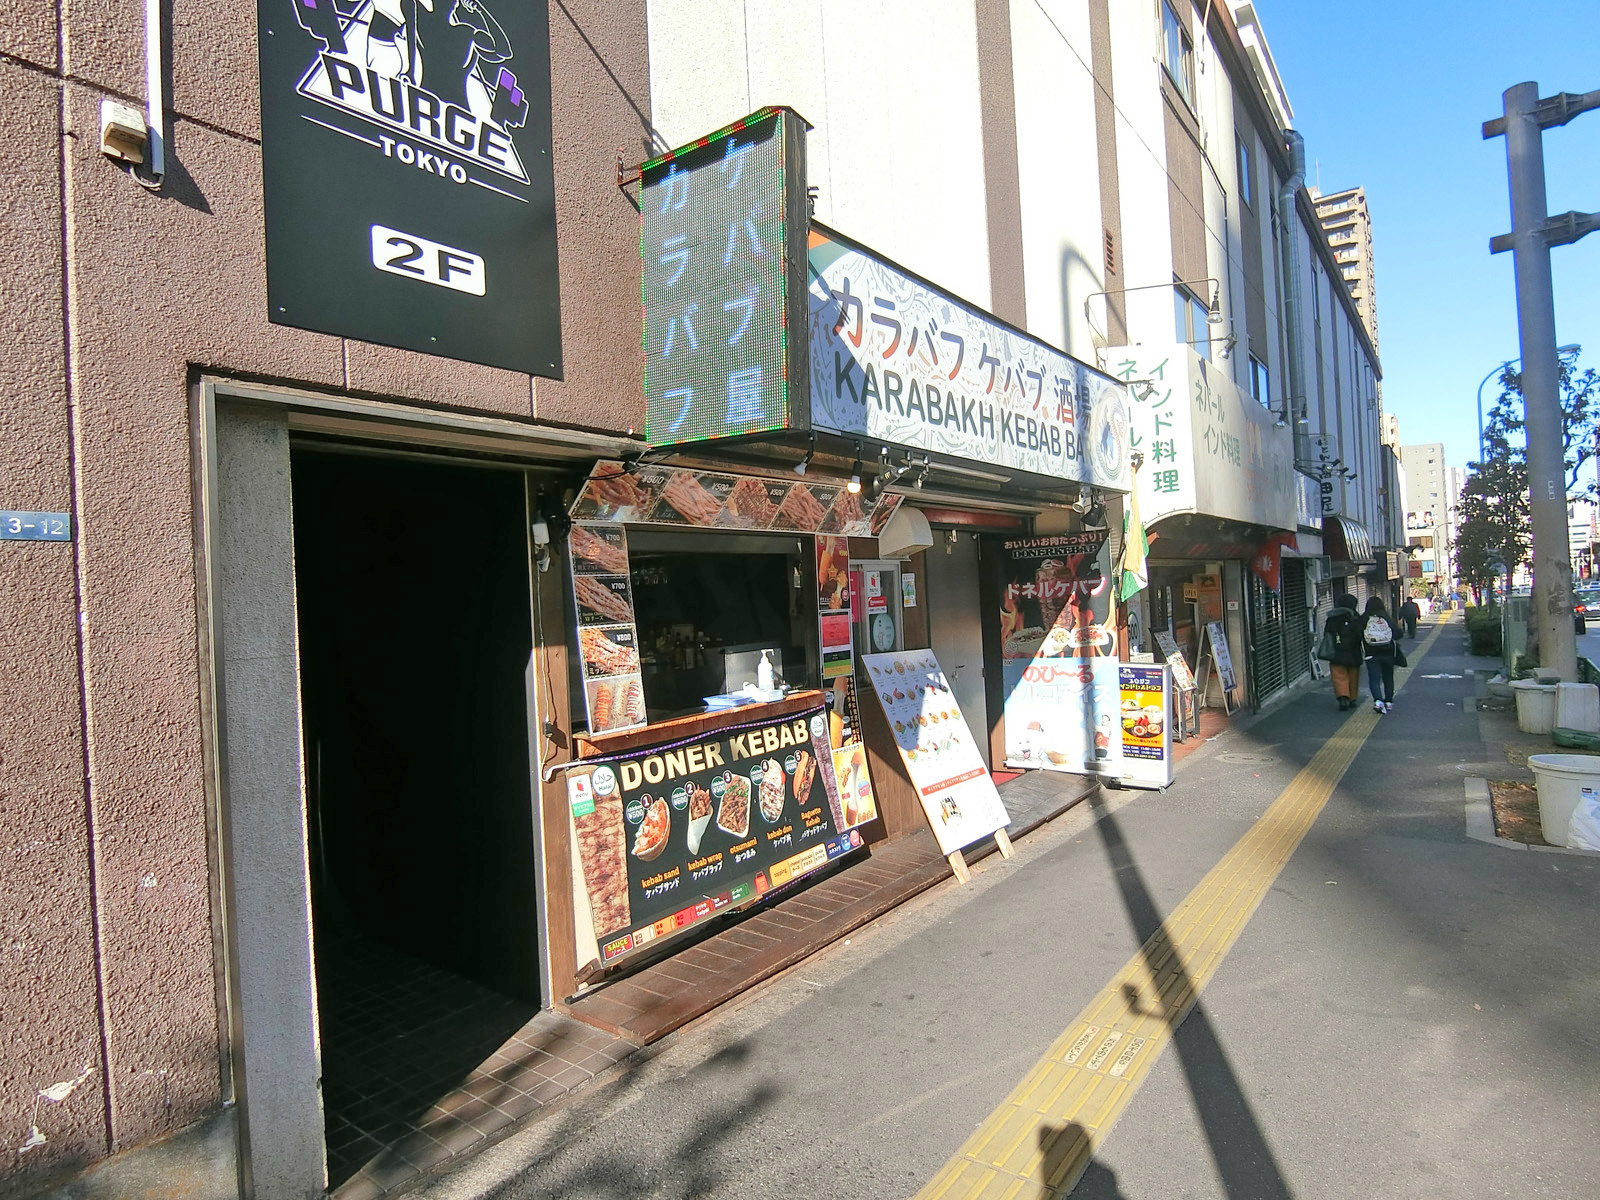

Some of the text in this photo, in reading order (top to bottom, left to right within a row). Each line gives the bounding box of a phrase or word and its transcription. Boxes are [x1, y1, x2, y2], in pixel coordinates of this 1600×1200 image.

[319, 51, 512, 167] PURGE
[379, 135, 468, 184] TOKYO
[386, 236, 475, 283] 2F
[831, 276, 964, 381] カラバフ
[834, 350, 995, 441] KARABAKH
[1000, 407, 1062, 457] KEBAB
[619, 719, 809, 791] DONER KEBAB
[795, 751, 801, 760] 5
[594, 773, 613, 785] حلال
[725, 772, 731, 782] 3
[687, 783, 693, 793] 2
[643, 796, 649, 806] 1
[729, 837, 758, 854] otsumami
[688, 852, 723, 871] kebab wrap
[735, 848, 756, 863] おつまみ
[641, 866, 680, 888] kebab sand
[645, 878, 680, 898] ケバブサンド
[607, 938, 628, 951] SAUCE
